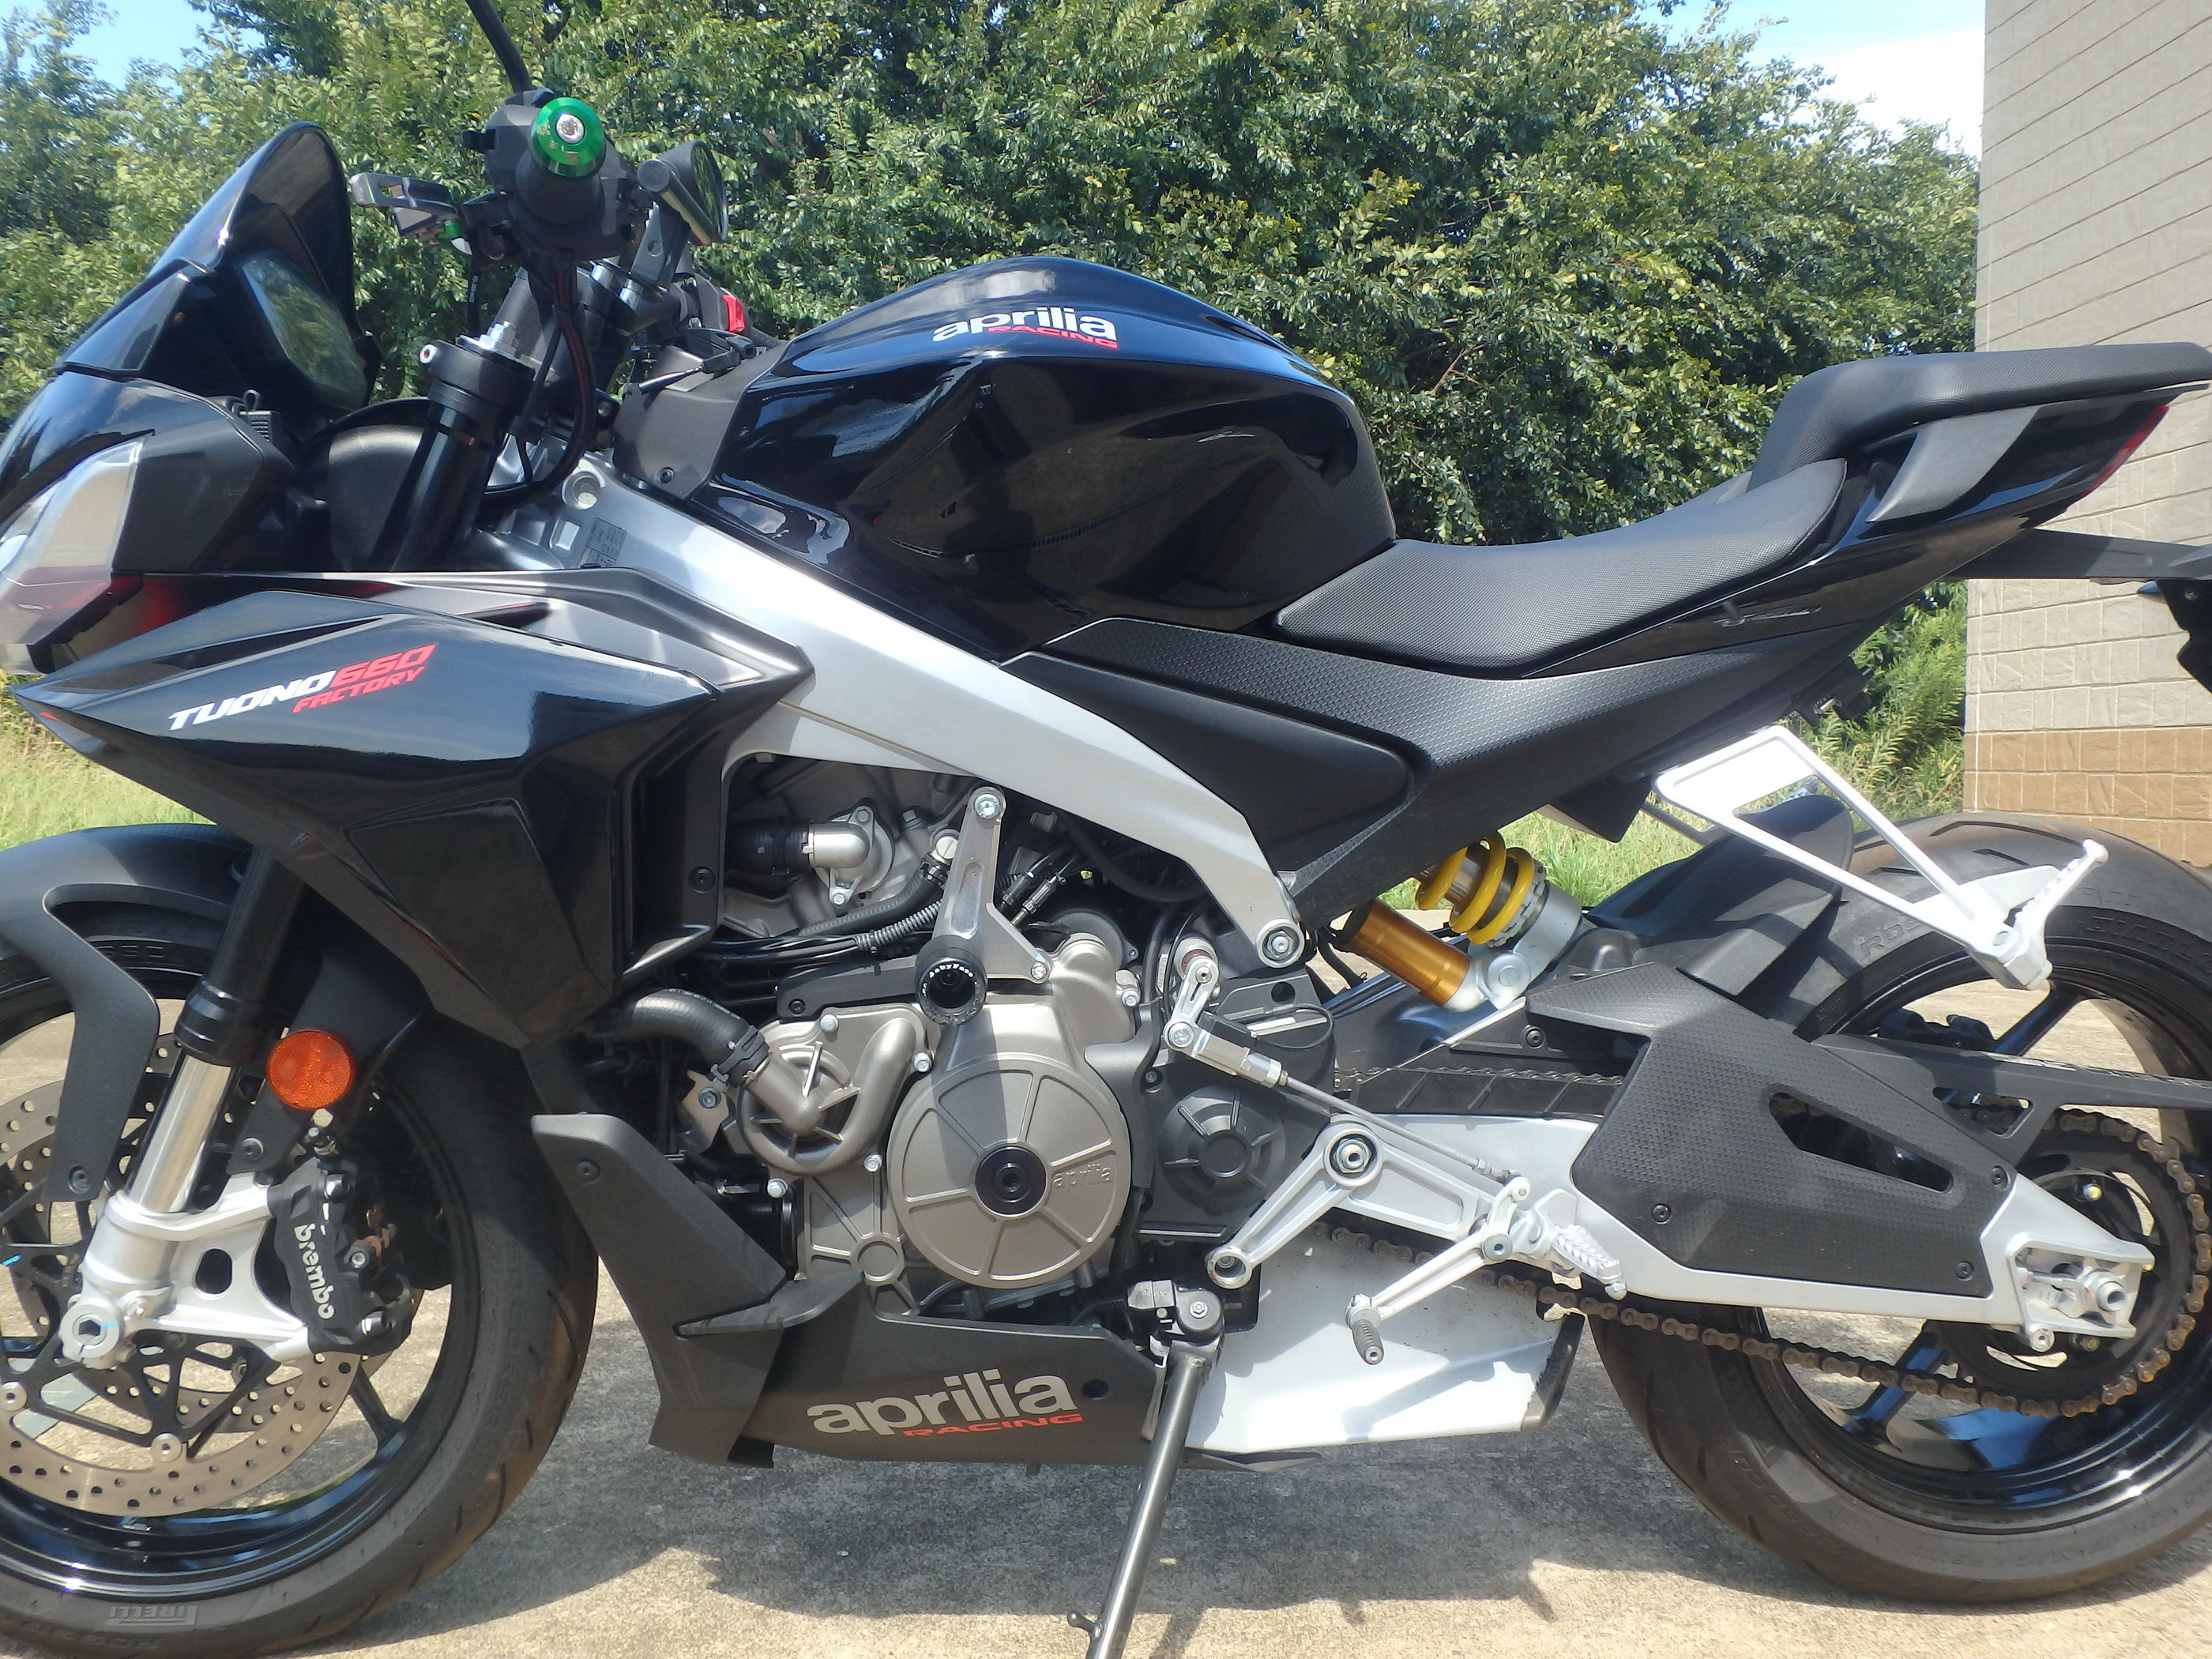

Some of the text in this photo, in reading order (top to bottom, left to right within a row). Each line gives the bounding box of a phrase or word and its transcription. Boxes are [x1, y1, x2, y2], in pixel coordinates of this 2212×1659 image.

[932, 307, 1118, 342] aprilia
[988, 325, 1119, 349] RACING
[292, 666, 426, 713] FACTORY
[1052, 1163, 1112, 1191] aprilia
[293, 1223, 334, 1319] brembo
[807, 1368, 1078, 1436] aprilia
[902, 1413, 1084, 1437] RACING
[107, 1604, 198, 1627] PIRELLI
